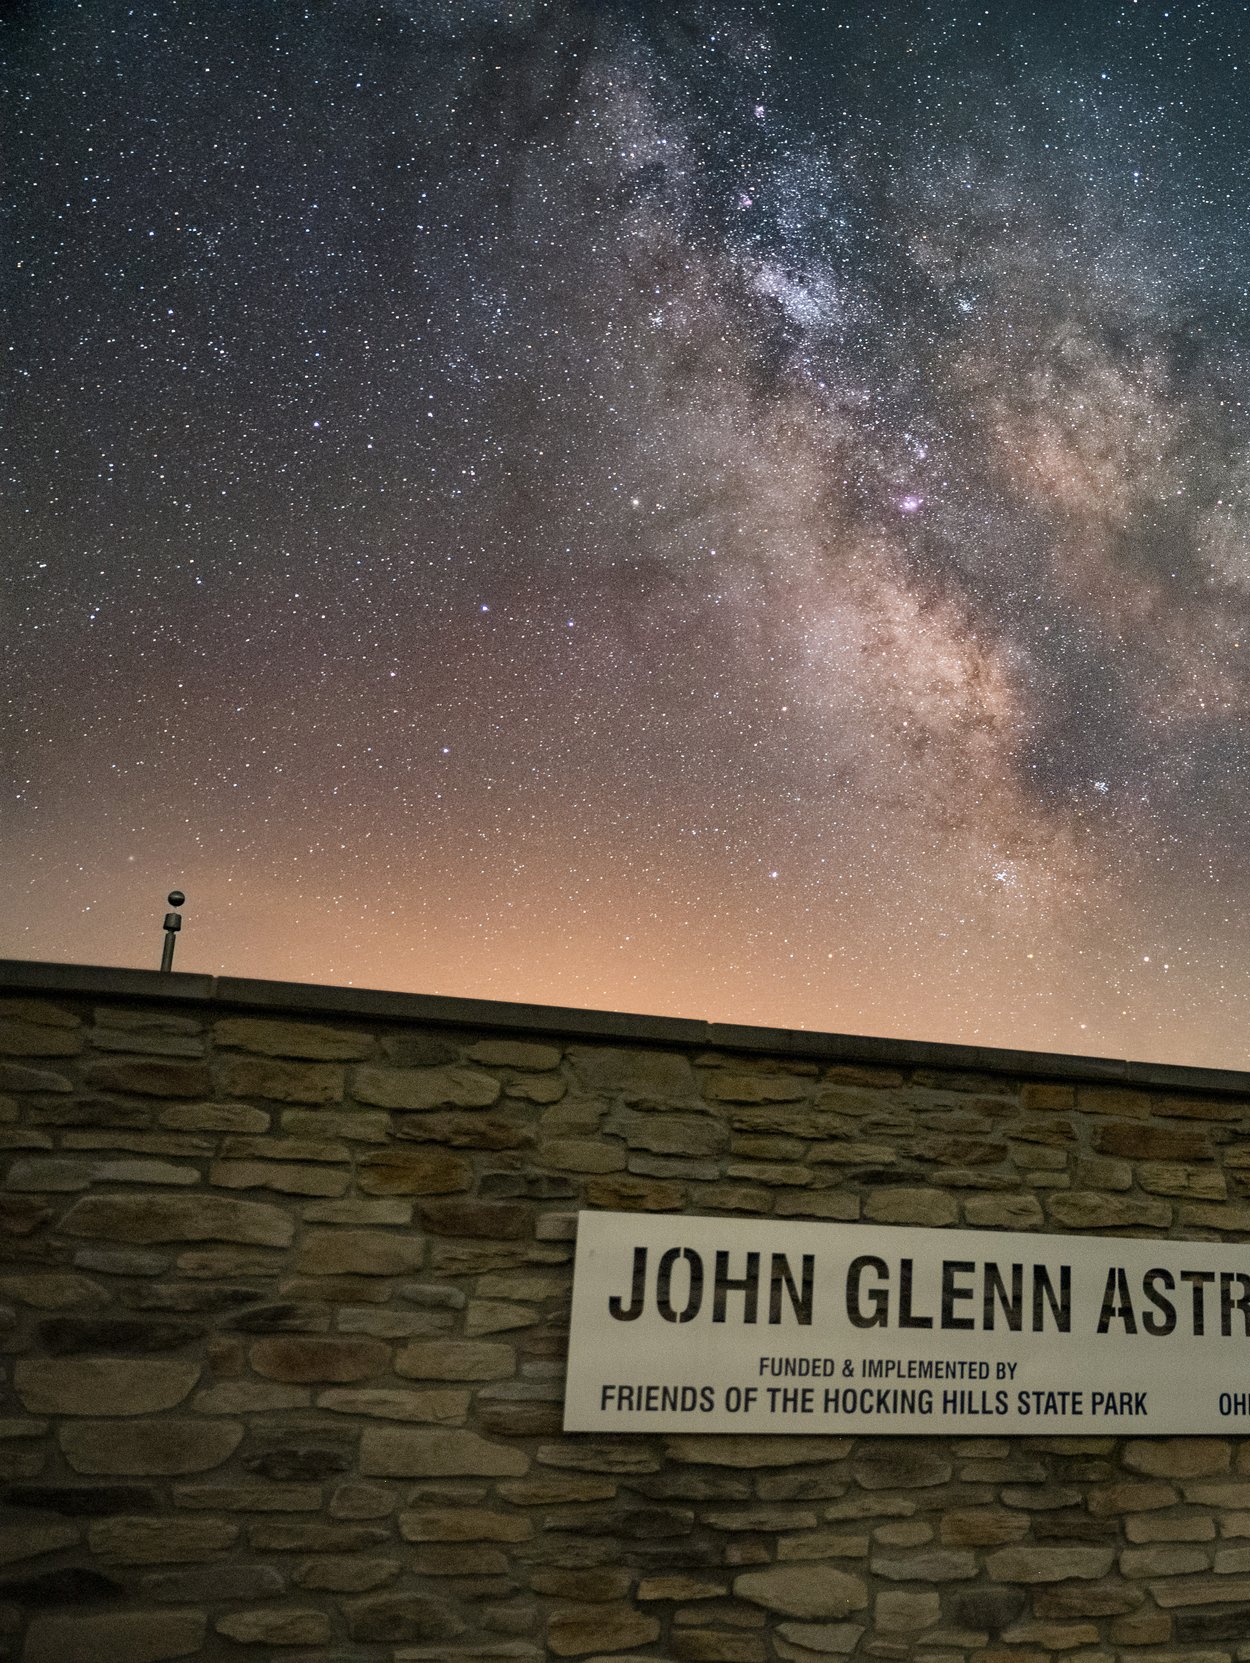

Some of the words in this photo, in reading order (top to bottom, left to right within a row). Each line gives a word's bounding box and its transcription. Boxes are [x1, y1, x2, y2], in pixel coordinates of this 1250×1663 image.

[609, 1247, 815, 1325] JOHN
[846, 1255, 1071, 1333] GLENN
[760, 1358, 834, 1377] FUNDED
[842, 1359, 854, 1377] &
[862, 1360, 989, 1379] IMPLEMENTED
[997, 1362, 1017, 1380] BY
[601, 1385, 714, 1412] FRIENDS
[726, 1387, 758, 1412] OF
[767, 1388, 814, 1413] THE
[824, 1389, 932, 1414] HOCKING
[943, 1390, 1008, 1415] HILLS
[1018, 1391, 1083, 1415] STATE
[1092, 1392, 1147, 1415] PARK
